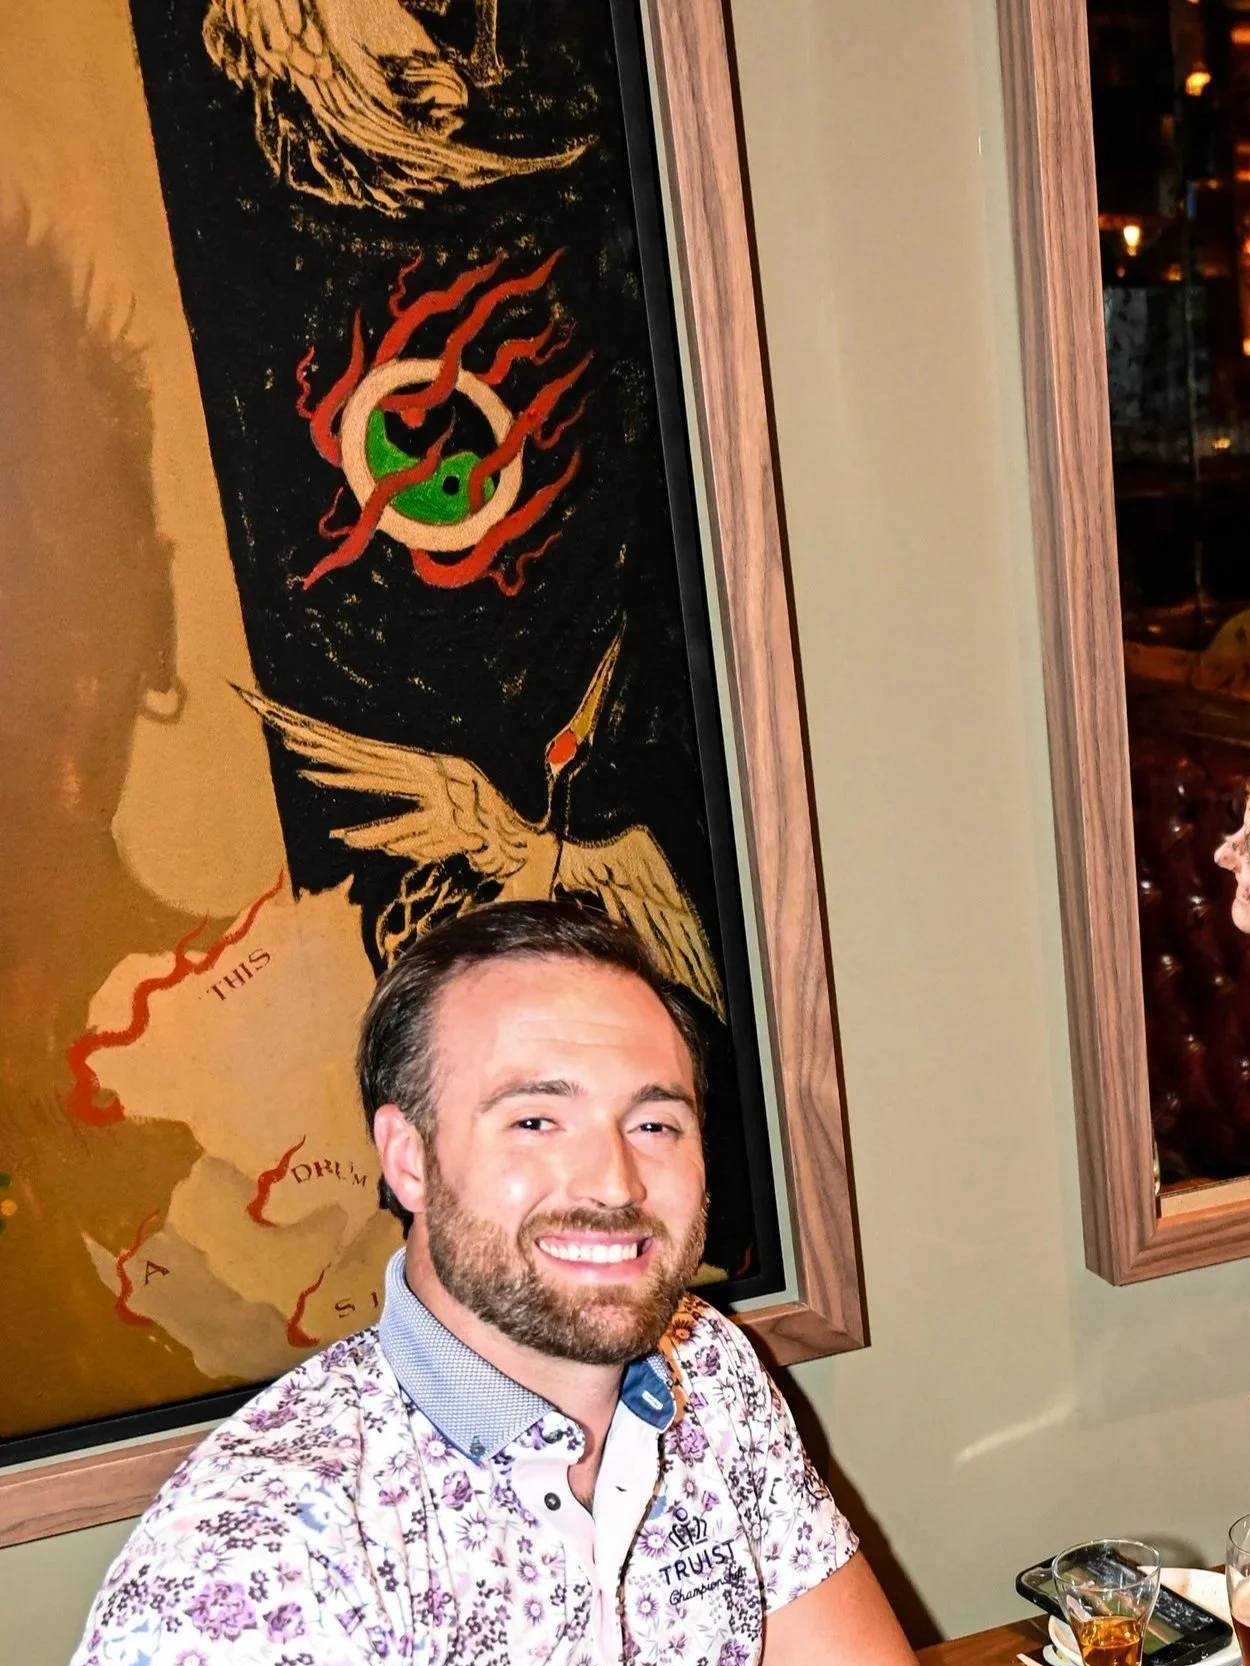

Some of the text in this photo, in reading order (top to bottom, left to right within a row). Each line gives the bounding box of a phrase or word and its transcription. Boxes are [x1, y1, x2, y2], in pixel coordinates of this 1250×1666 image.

[205, 947, 271, 1001] THIS
[290, 1158, 368, 1188] DRUM
[144, 1259, 171, 1288] A
[658, 1539, 735, 1586] TRUIST
